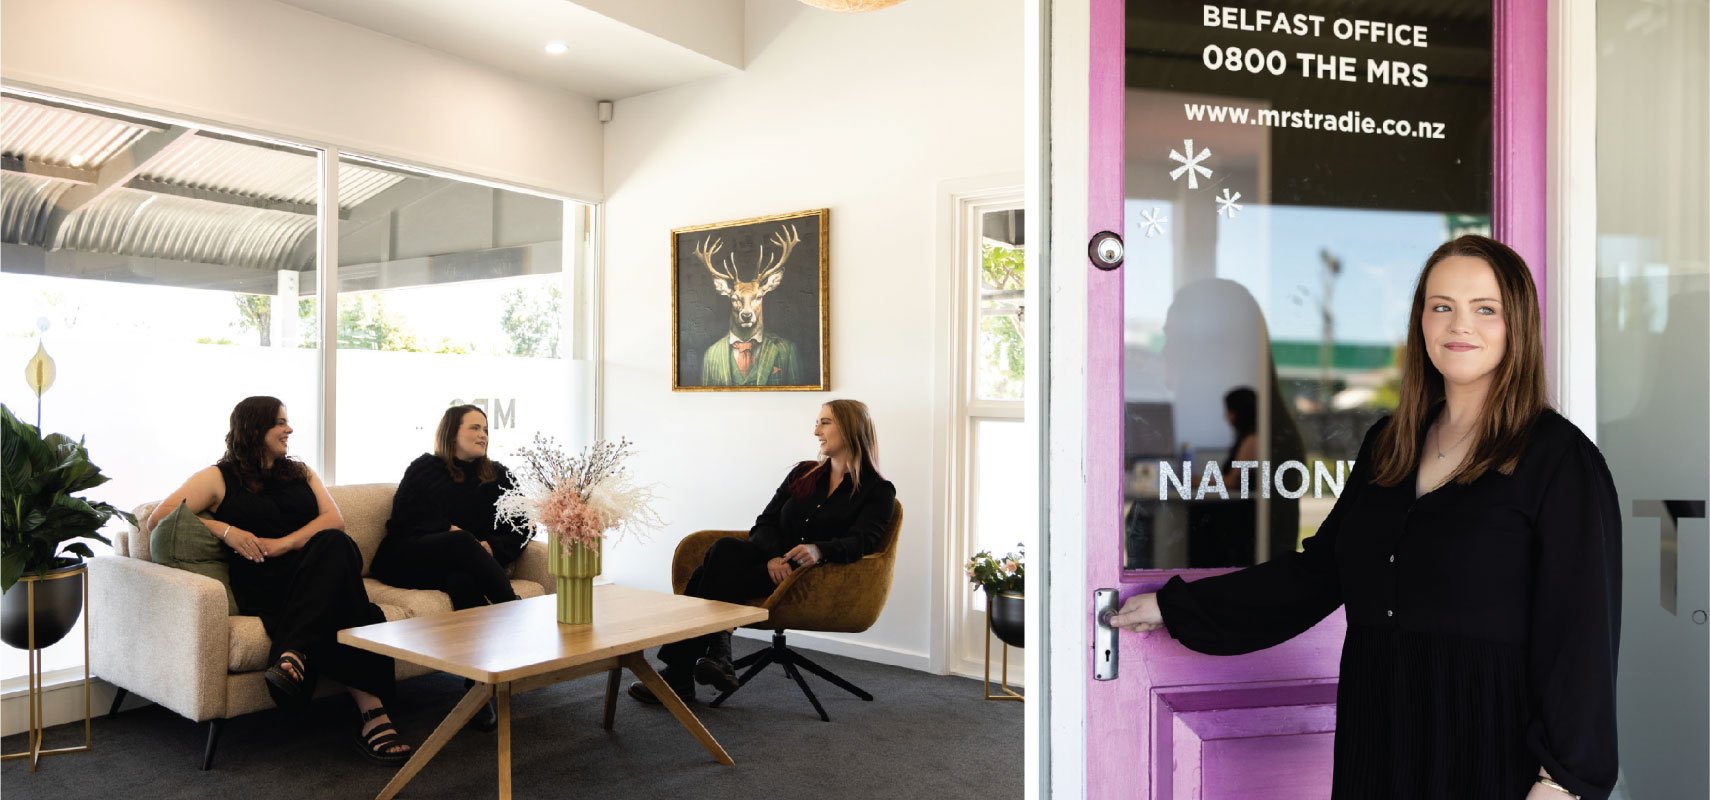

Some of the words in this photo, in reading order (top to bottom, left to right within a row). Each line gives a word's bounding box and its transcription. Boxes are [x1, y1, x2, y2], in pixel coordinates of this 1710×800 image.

[1203, 5, 1325, 37] BELFAST
[1333, 18, 1428, 48] OFFICE
[1203, 45, 1287, 76] 0800
[1297, 52, 1357, 82] THE
[1367, 59, 1429, 88] MRS
[1184, 103, 1446, 139] www.mrstradie.co.nz
[1159, 460, 1356, 500] NATION
